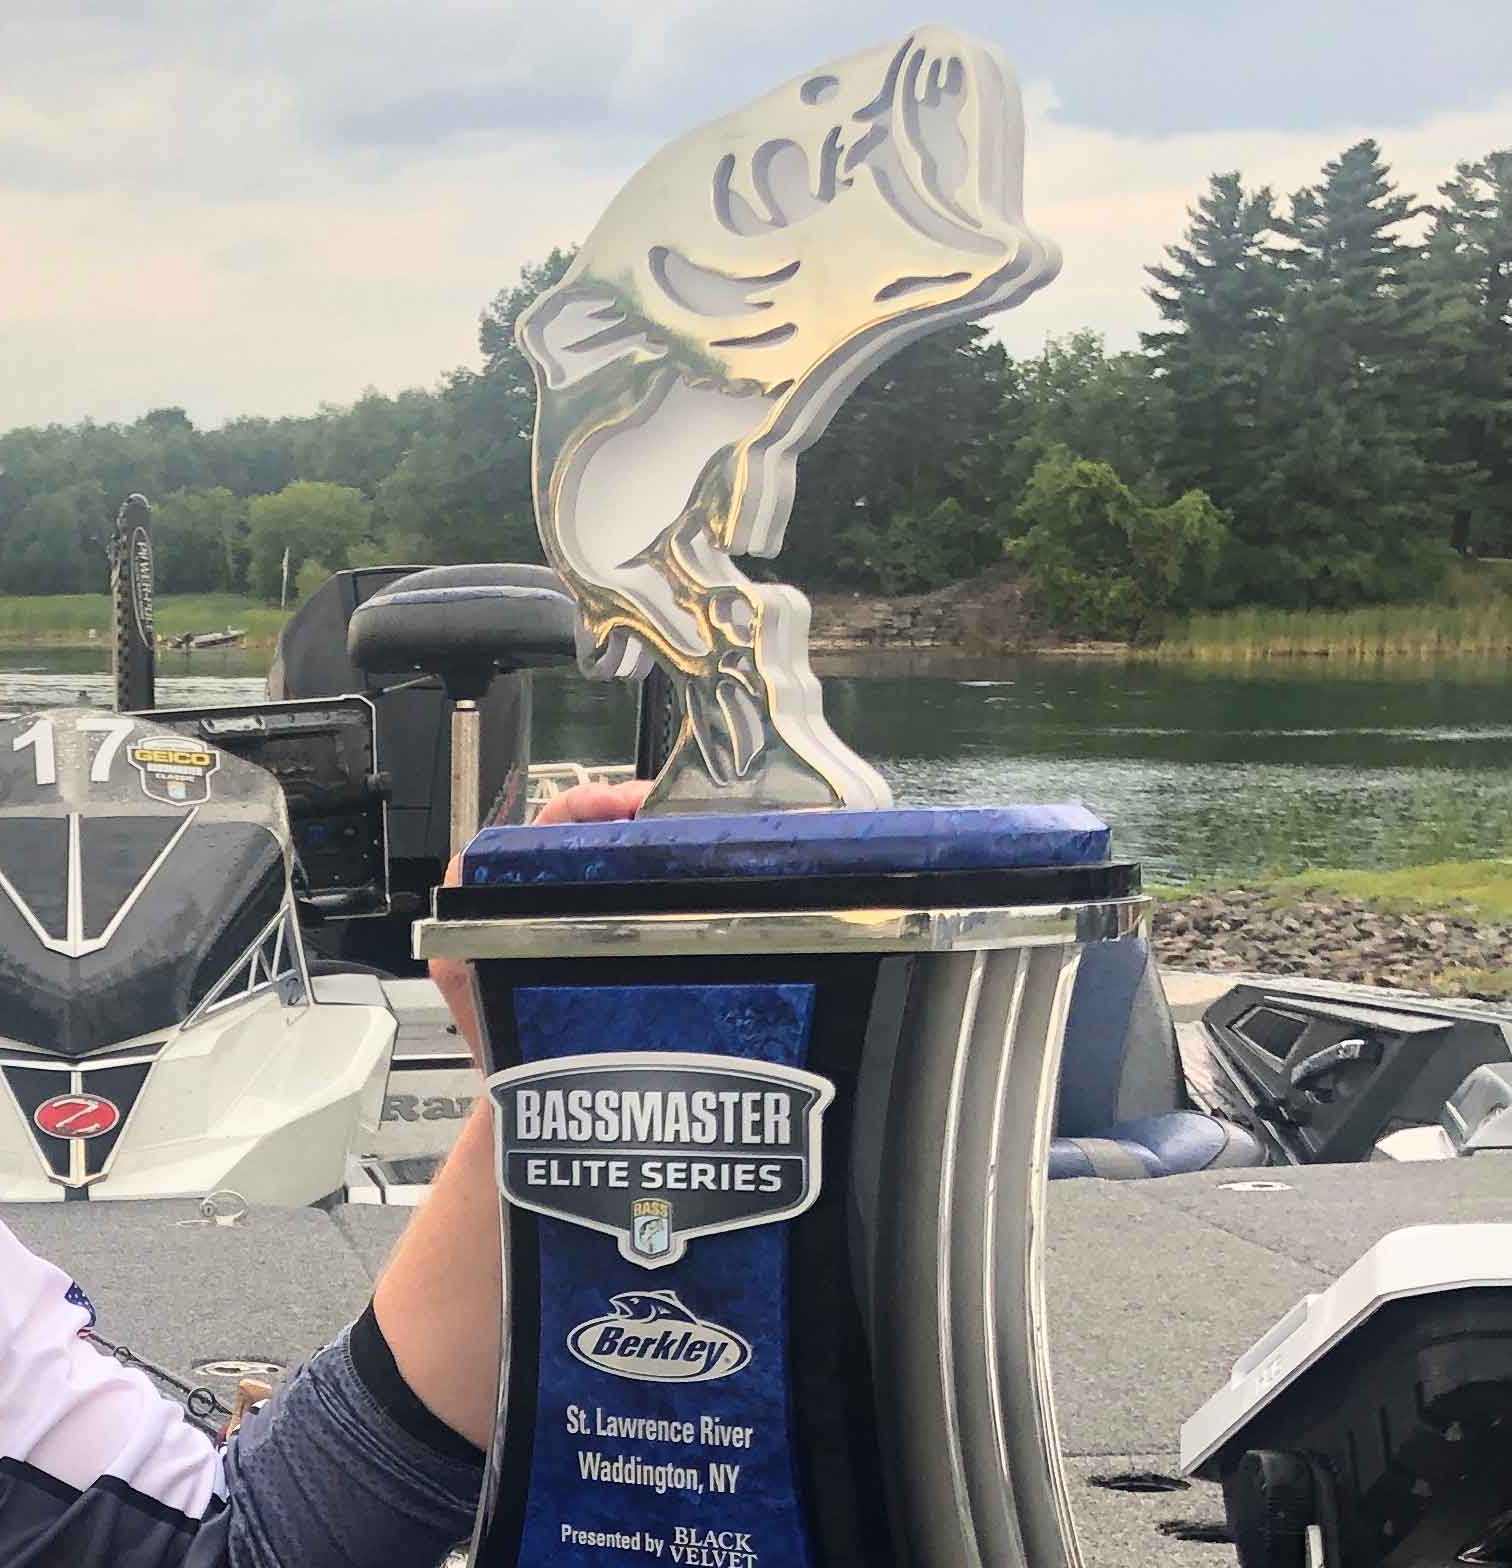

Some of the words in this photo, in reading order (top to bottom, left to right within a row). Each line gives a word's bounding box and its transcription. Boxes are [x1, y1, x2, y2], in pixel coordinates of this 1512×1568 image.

[12, 717, 135, 786] 17
[134, 748, 211, 768] GEICO
[515, 1089, 792, 1145] BASSMASTER
[527, 1159, 630, 1189] ELITE
[640, 1161, 782, 1192] SERIES
[592, 1326, 728, 1374] Berkley
[566, 1404, 591, 1435] St.
[596, 1407, 694, 1444] Lawrence
[700, 1415, 754, 1449] River
[577, 1450, 705, 1495] Waddington,
[709, 1462, 741, 1494] NY
[561, 1523, 640, 1551] Presented
[645, 1532, 664, 1558] by
[669, 1545, 758, 1568] VELVET
[674, 1526, 753, 1553] BLACK
